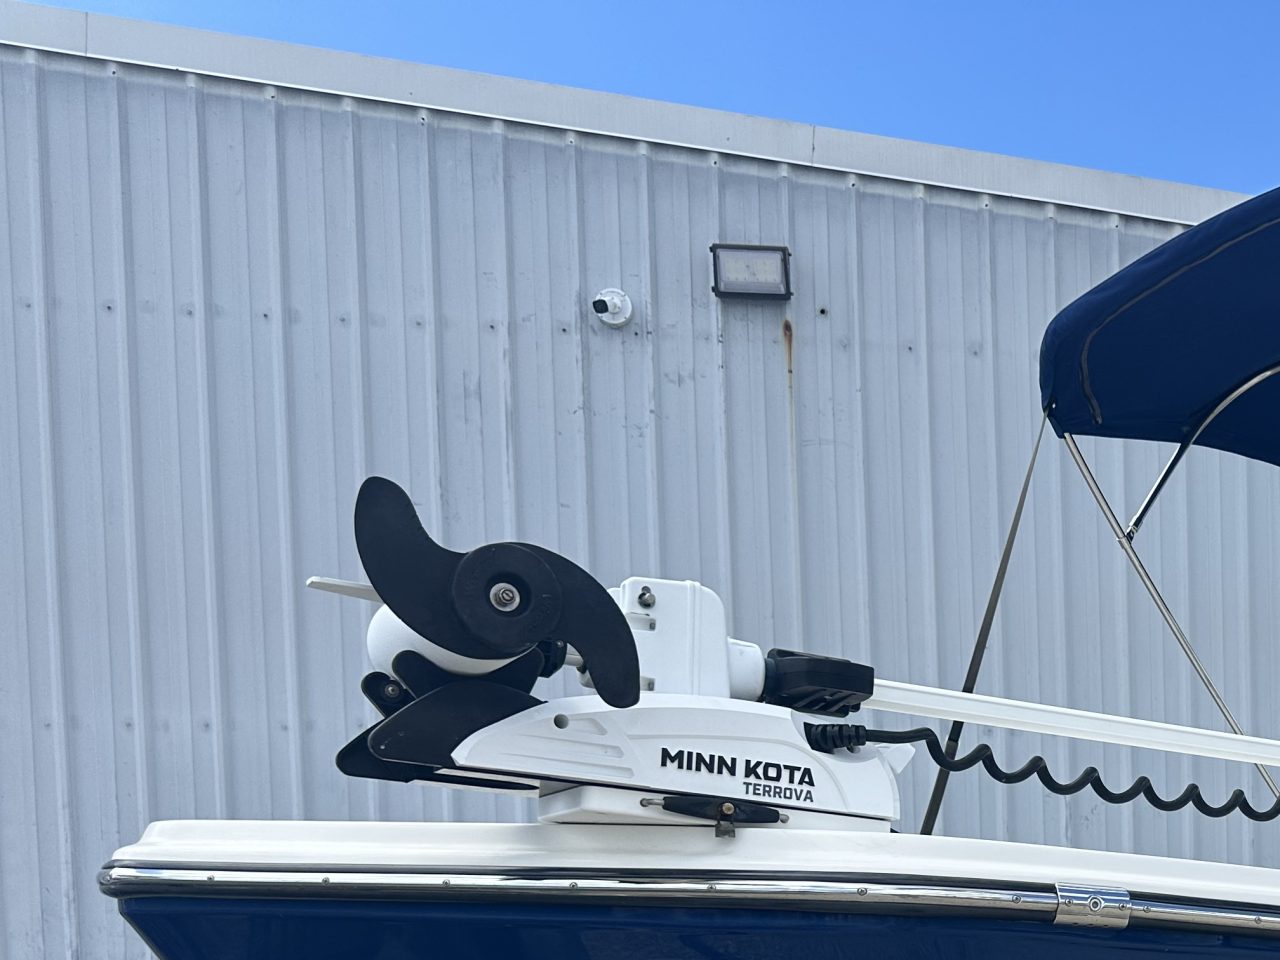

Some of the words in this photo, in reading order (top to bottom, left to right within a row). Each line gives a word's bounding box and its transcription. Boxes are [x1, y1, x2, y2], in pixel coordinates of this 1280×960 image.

[661, 747, 737, 777] MINN
[744, 759, 815, 787] KOTA
[743, 781, 814, 803] TERROVA
